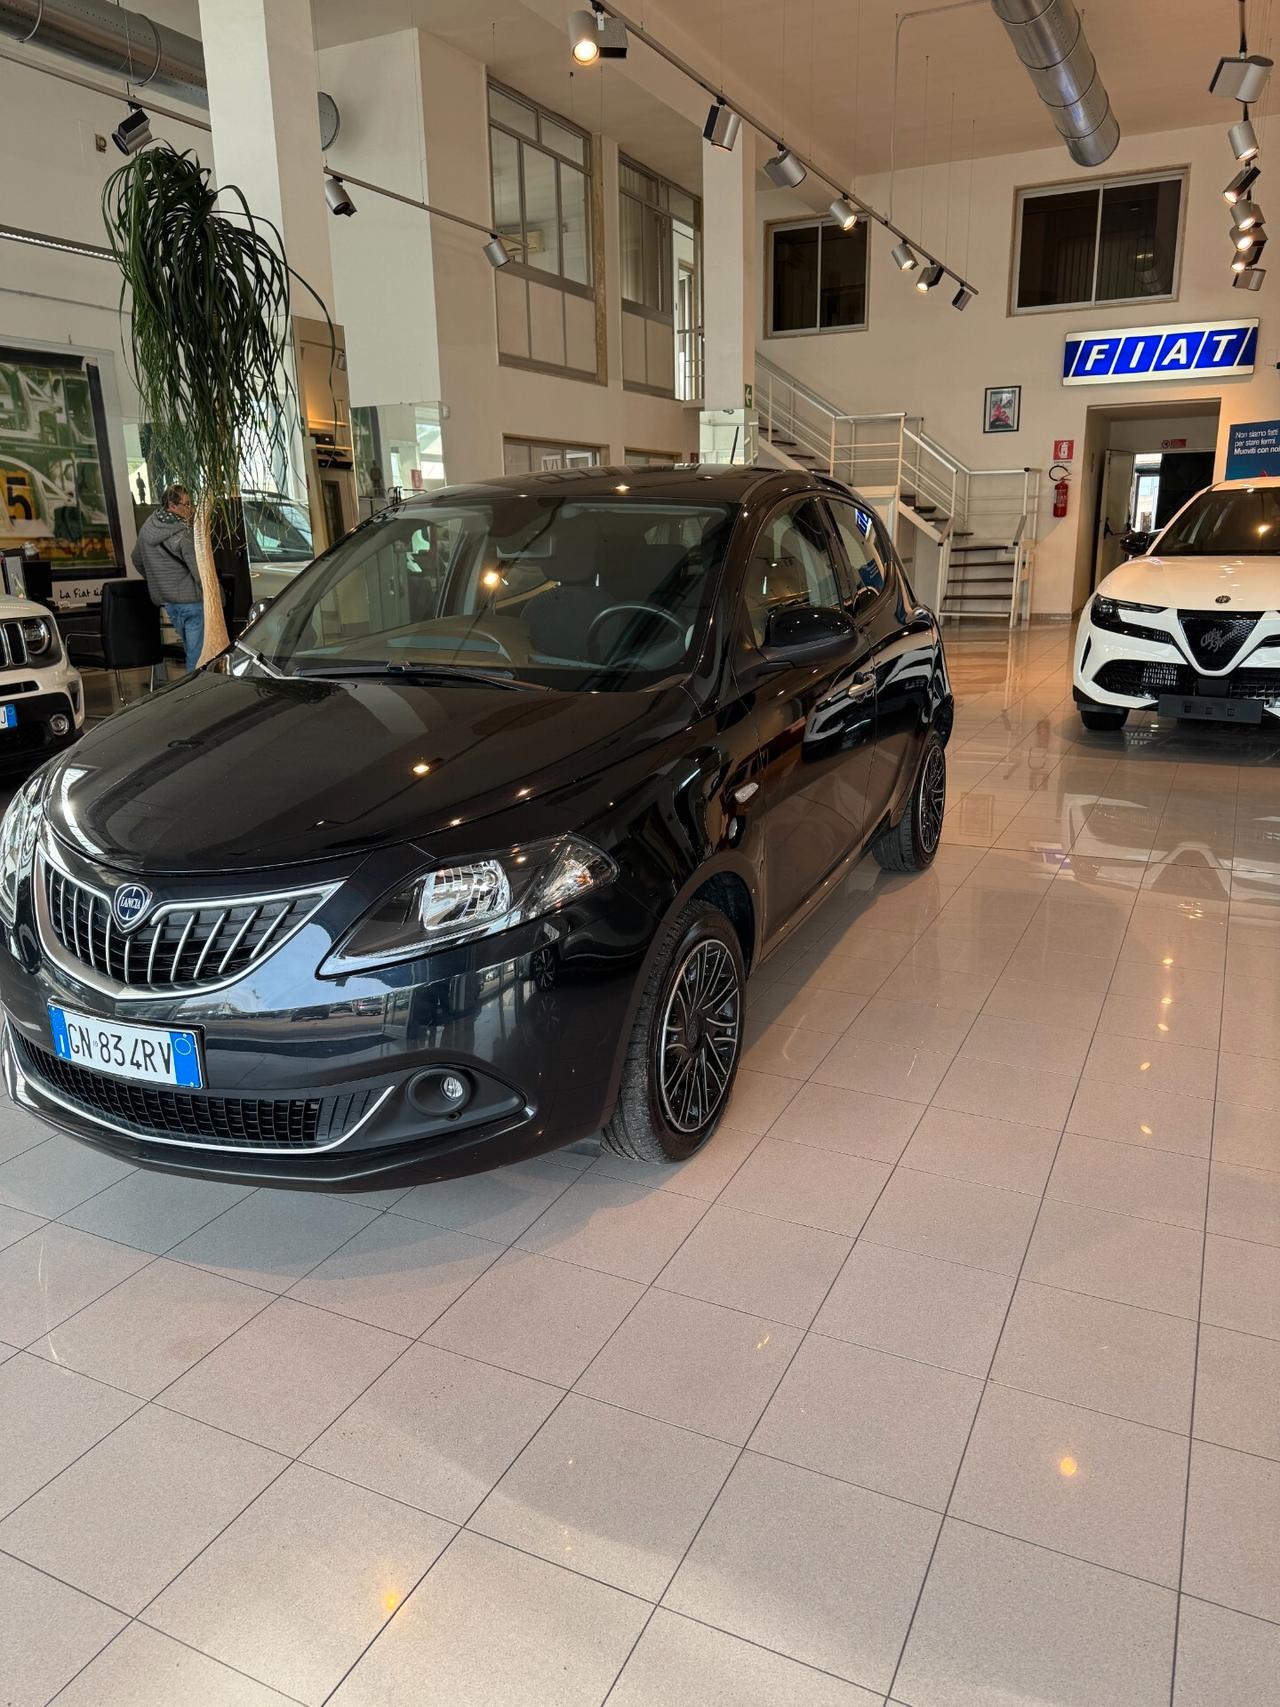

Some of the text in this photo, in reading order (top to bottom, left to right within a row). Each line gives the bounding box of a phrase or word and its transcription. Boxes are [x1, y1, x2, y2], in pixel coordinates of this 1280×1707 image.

[1084, 334, 1237, 371] FIAT
[1235, 431, 1248, 439] Non
[1249, 429, 1267, 438] siamo
[1234, 441, 1245, 449] per
[1245, 439, 1259, 447] stare
[1233, 446, 1256, 455] Muoviti
[1257, 446, 1270, 454] con
[60, 589, 71, 599] La
[120, 896, 141, 910] LANCIA
